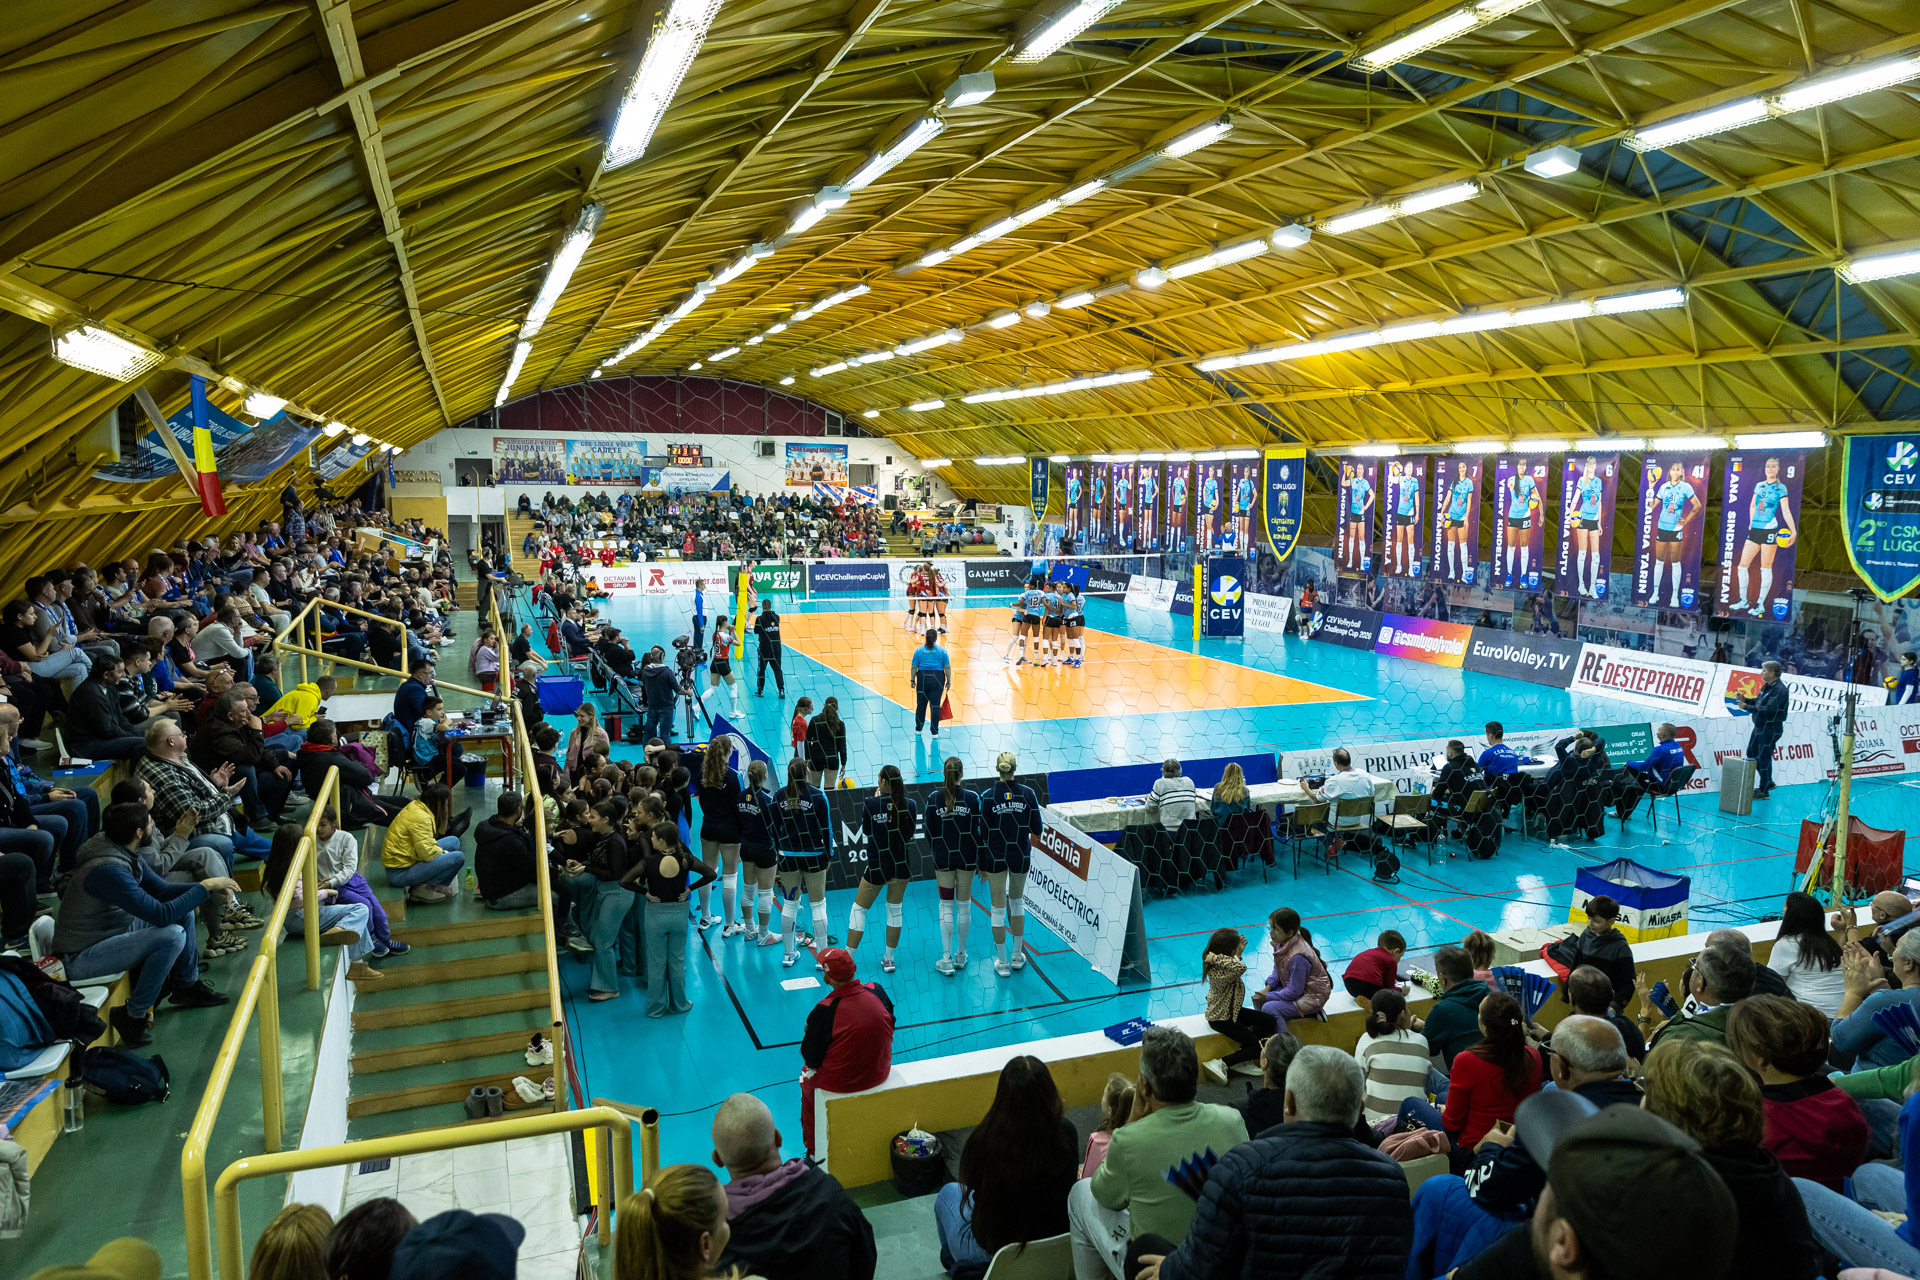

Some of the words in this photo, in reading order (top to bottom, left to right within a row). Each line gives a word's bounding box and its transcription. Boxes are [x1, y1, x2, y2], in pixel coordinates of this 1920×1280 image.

[1472, 466, 1478, 477] 7
[1534, 466, 1546, 478] 23
[1606, 464, 1613, 477] 6
[1692, 465, 1704, 478] 41
[1787, 466, 1795, 478] 9
[1884, 474, 1916, 484] CEV
[1728, 474, 1740, 504] ANA
[1563, 480, 1574, 538] MELANIA
[1642, 488, 1654, 549] CLAUDIA
[1766, 534, 1774, 544] 9
[1494, 518, 1504, 576] KINDELAN
[774, 571, 800, 581] GYM
[814, 573, 886, 582] #CEVChallengeCupW
[968, 570, 1010, 578] GAMMET
[1638, 552, 1650, 594] TARIN
[1088, 577, 1127, 592] EuroVolley.TV
[1030, 596, 1039, 606] 12
[1210, 608, 1242, 620] CEV
[1326, 616, 1338, 624] CEV
[1338, 617, 1362, 628] Volleyball
[1324, 624, 1348, 636] Challenge
[1348, 628, 1359, 638] Cup
[1393, 630, 1466, 656] @csmlugojvolei
[1472, 640, 1570, 671] EuroVolley.TV
[1579, 651, 1606, 683] RE
[1008, 802, 1027, 810] LUGOJ
[1040, 824, 1080, 868] Edenia
[1028, 865, 1100, 932] HIDROELECTRICA
